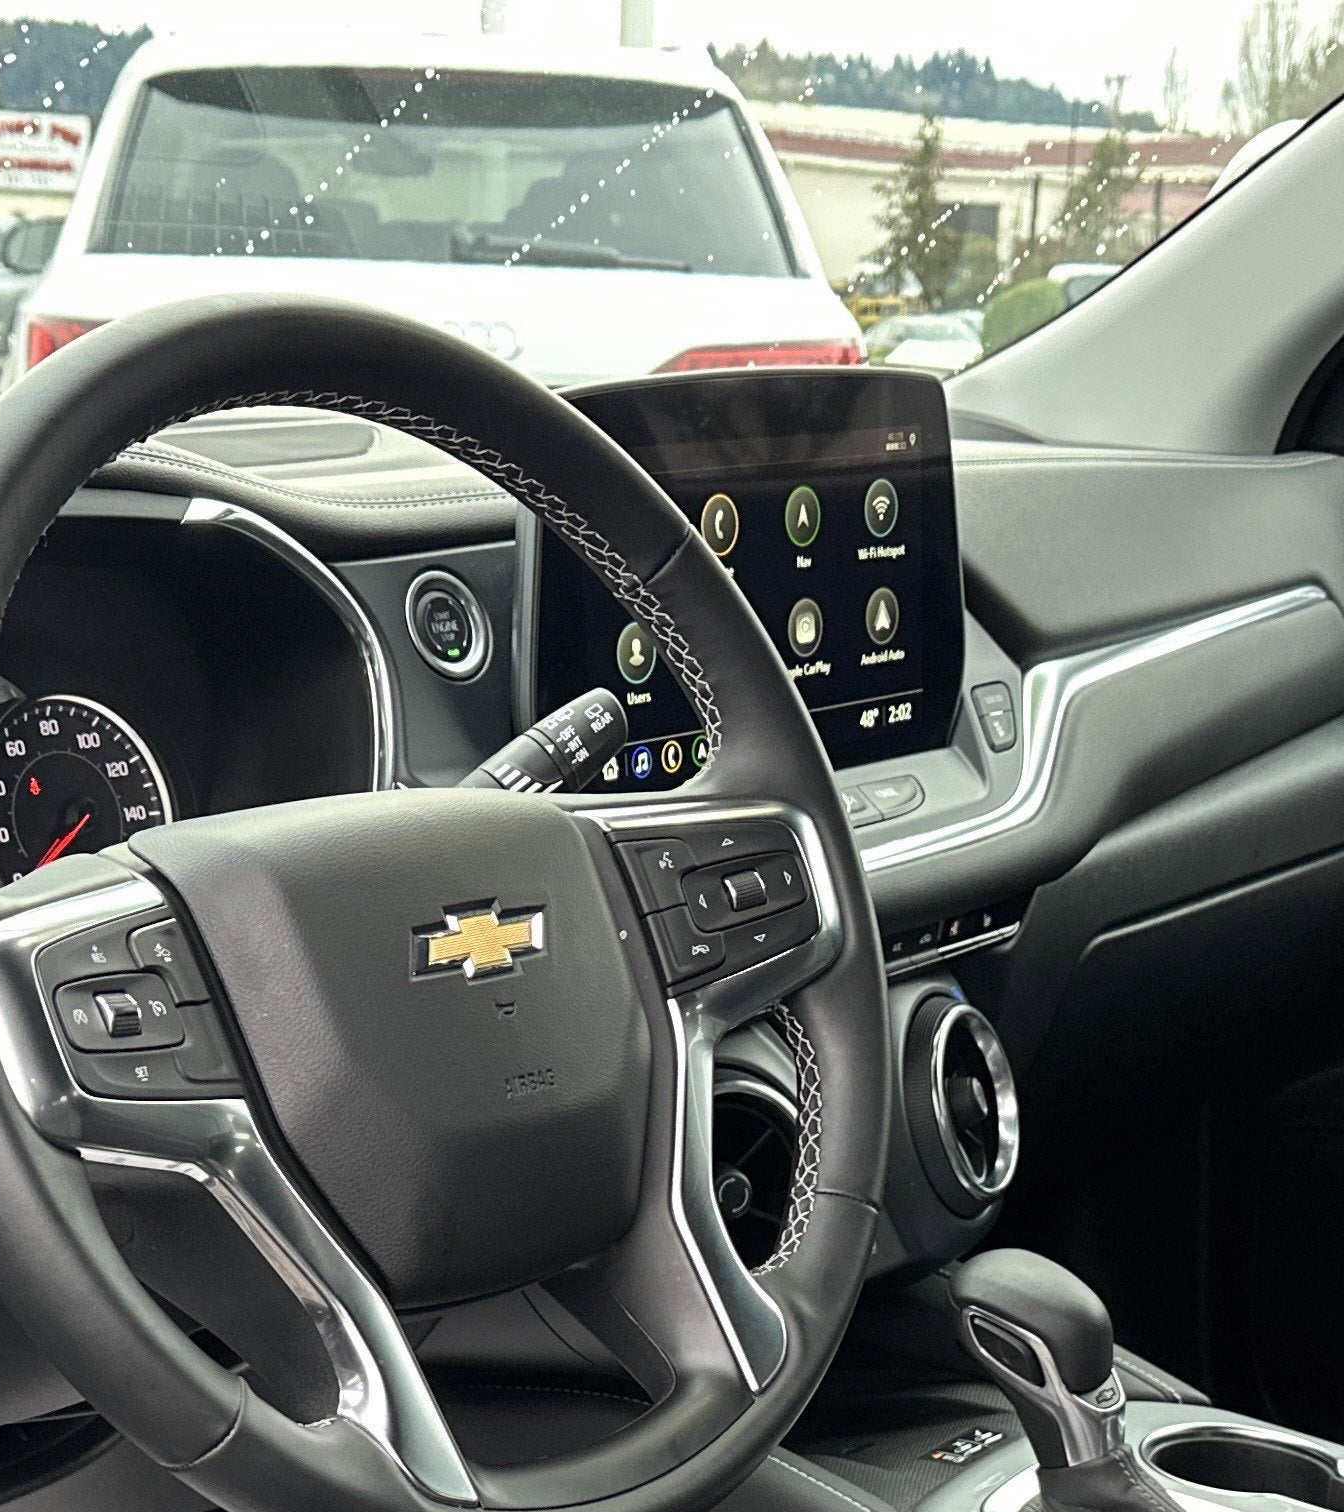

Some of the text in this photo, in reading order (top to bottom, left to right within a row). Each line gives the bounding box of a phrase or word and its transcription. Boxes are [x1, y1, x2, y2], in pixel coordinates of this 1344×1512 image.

[857, 544, 906, 560] Wi-Fi Hotspot
[796, 555, 812, 569] Nav
[860, 648, 906, 666] Android Auto
[803, 660, 832, 676] CarPlay
[626, 691, 652, 706] Users
[887, 702, 912, 723] 2:02
[39, 719, 60, 736] 80
[590, 711, 614, 734] REAR
[6, 740, 26, 757] 60
[76, 732, 101, 749] 100
[105, 761, 129, 778] 120
[123, 805, 146, 822] 140
